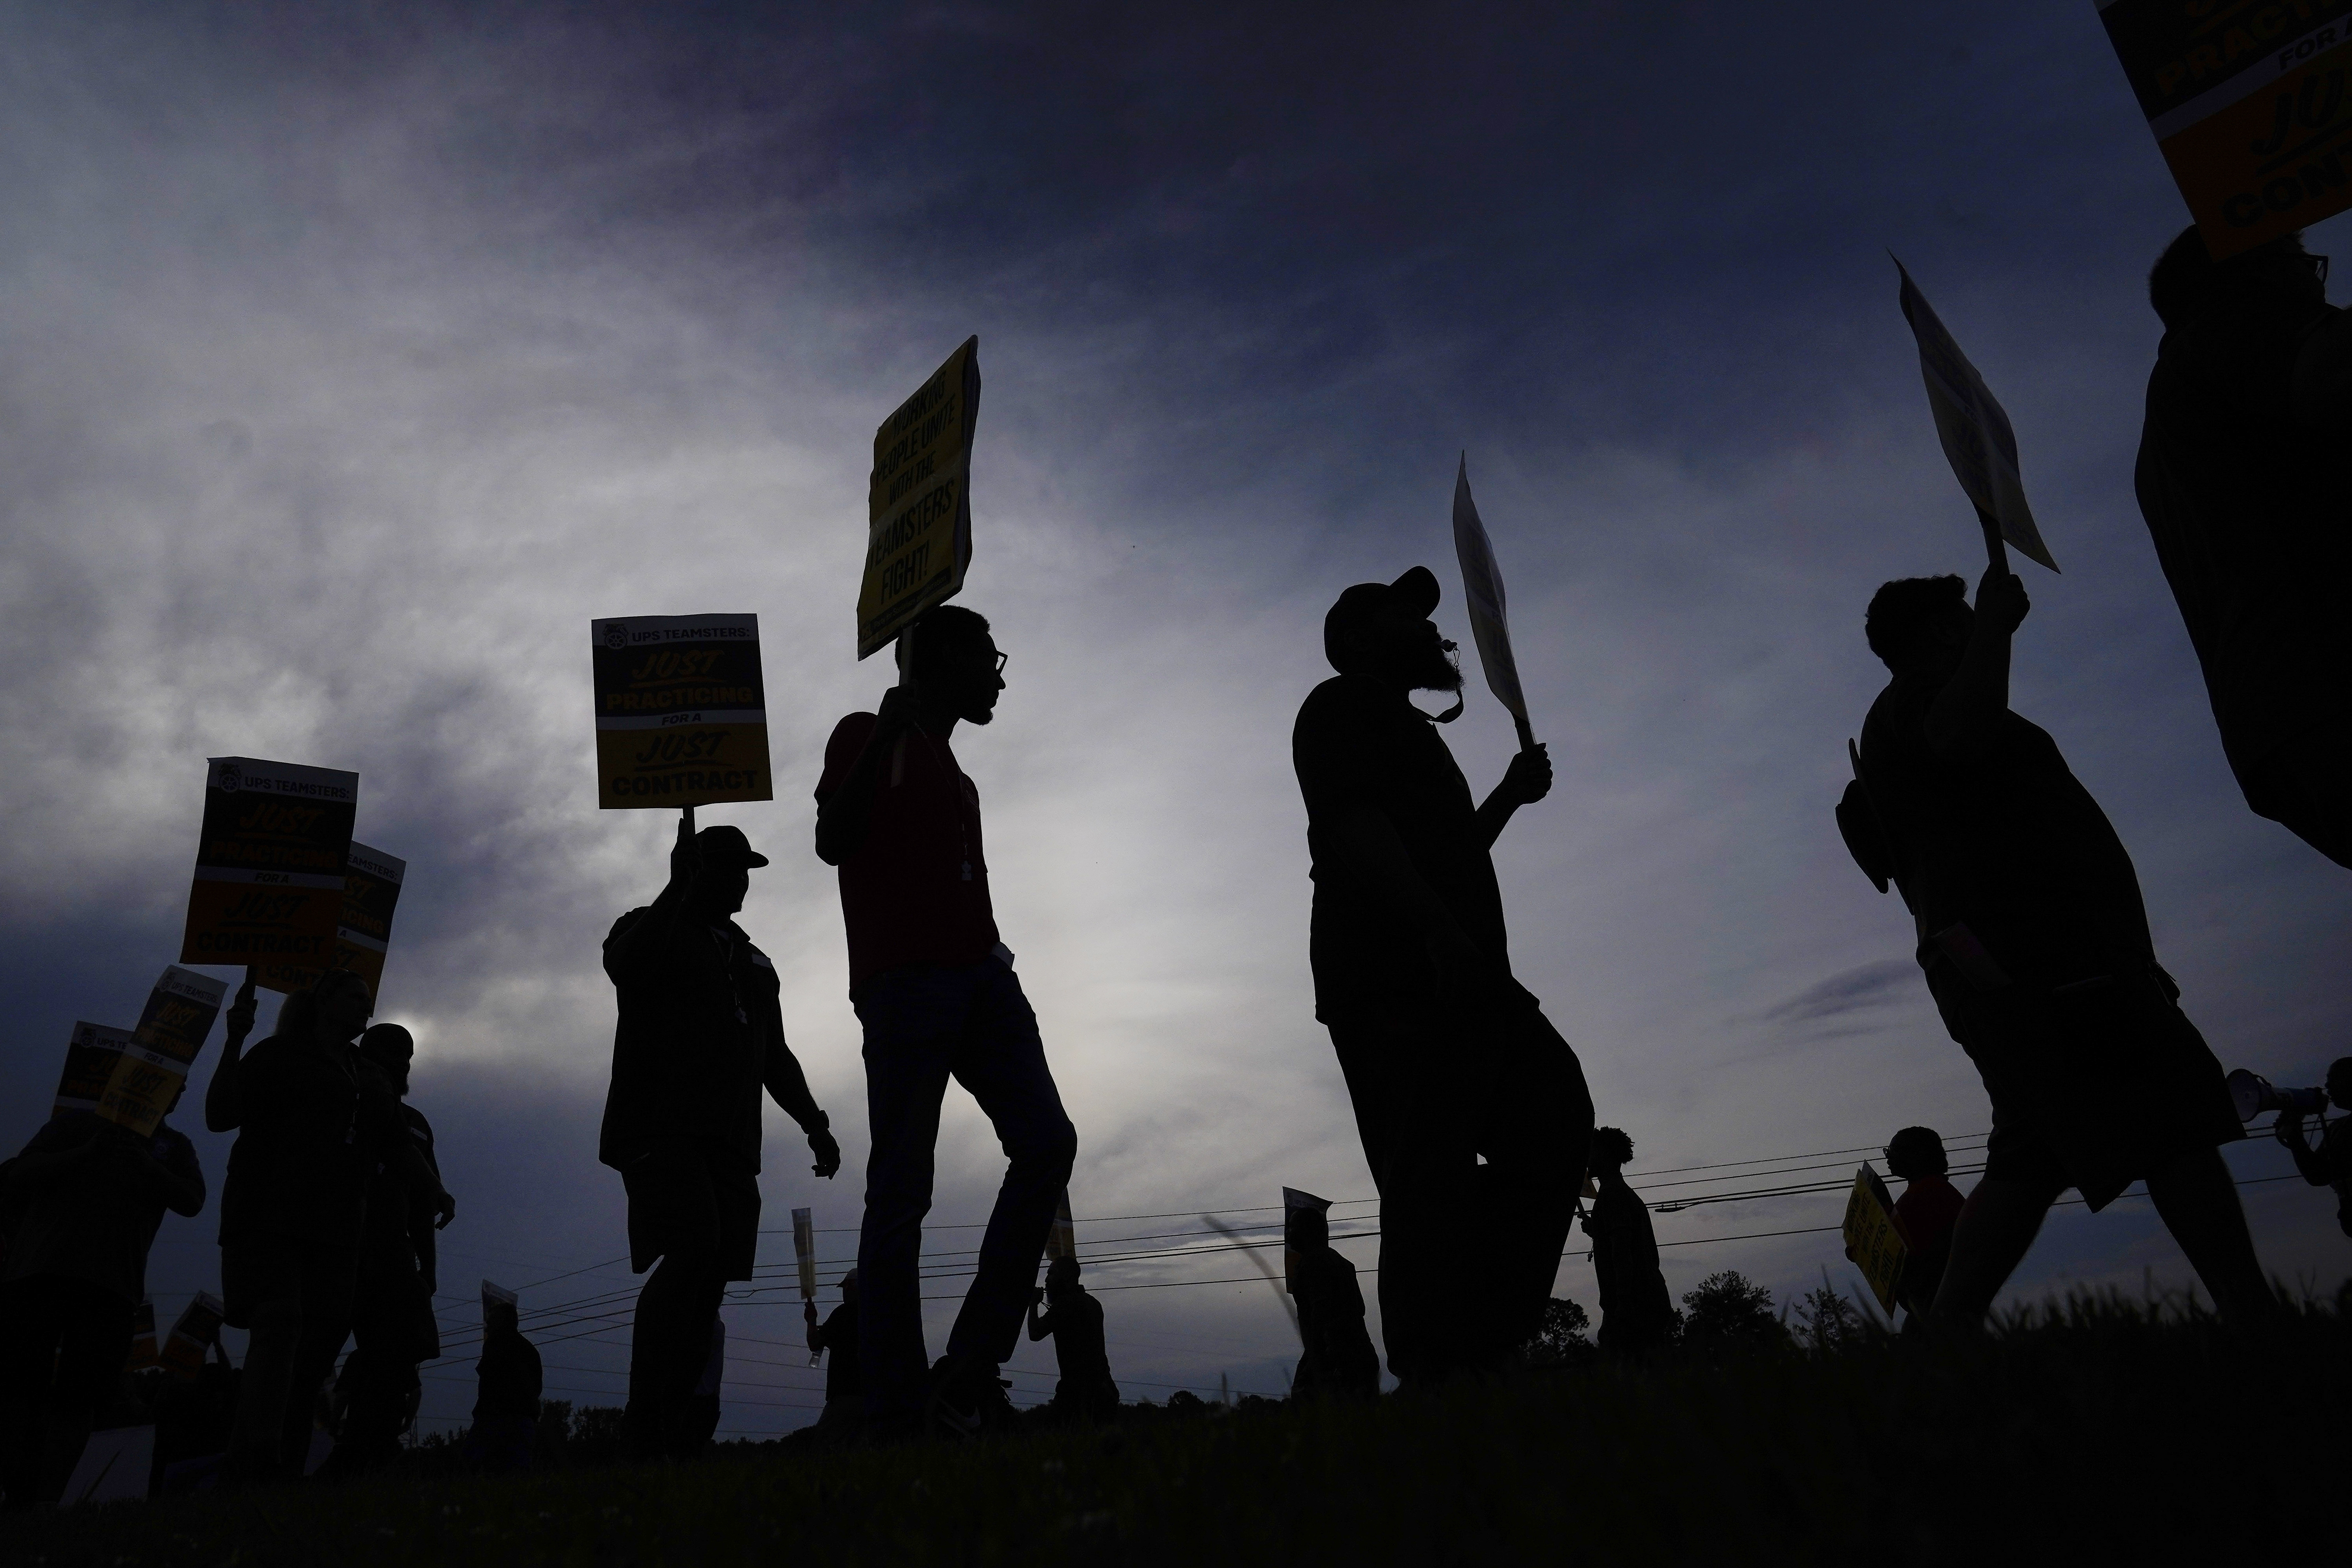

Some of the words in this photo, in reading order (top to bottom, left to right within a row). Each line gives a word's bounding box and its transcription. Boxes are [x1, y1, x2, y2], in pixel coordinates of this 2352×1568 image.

[2278, 27, 2336, 71] FOR
[893, 370, 946, 438] WORKING
[875, 427, 919, 489] PEOPLE
[921, 393, 956, 447] UNITE
[889, 467, 914, 507] WITH
[914, 449, 935, 489] THE
[868, 478, 954, 573] TEAMSTERS
[880, 539, 930, 606] FIGHT!
[632, 630, 660, 643] UPS
[663, 627, 750, 639] TEAMSTERS:
[631, 649, 725, 680] JUST
[606, 686, 754, 710] PRACTICING
[661, 714, 689, 726] FOR
[692, 712, 701, 722] A
[636, 730, 731, 764] JUST
[245, 776, 271, 789] UPS
[275, 779, 350, 799] TEAMSTERS:
[612, 769, 758, 796] CONTRACT
[239, 803, 326, 834] JUST
[211, 841, 339, 868] PRACTICING
[347, 853, 398, 880] EAMSTERS:
[254, 872, 279, 883] FOR
[280, 875, 289, 884] A
[344, 876, 375, 899] ST
[223, 891, 310, 920] JUST
[196, 930, 326, 955] CONTRACT
[339, 930, 347, 938] A
[171, 981, 184, 992] UPS
[96, 1037, 115, 1048] UPS
[144, 1052, 159, 1063] FOR
